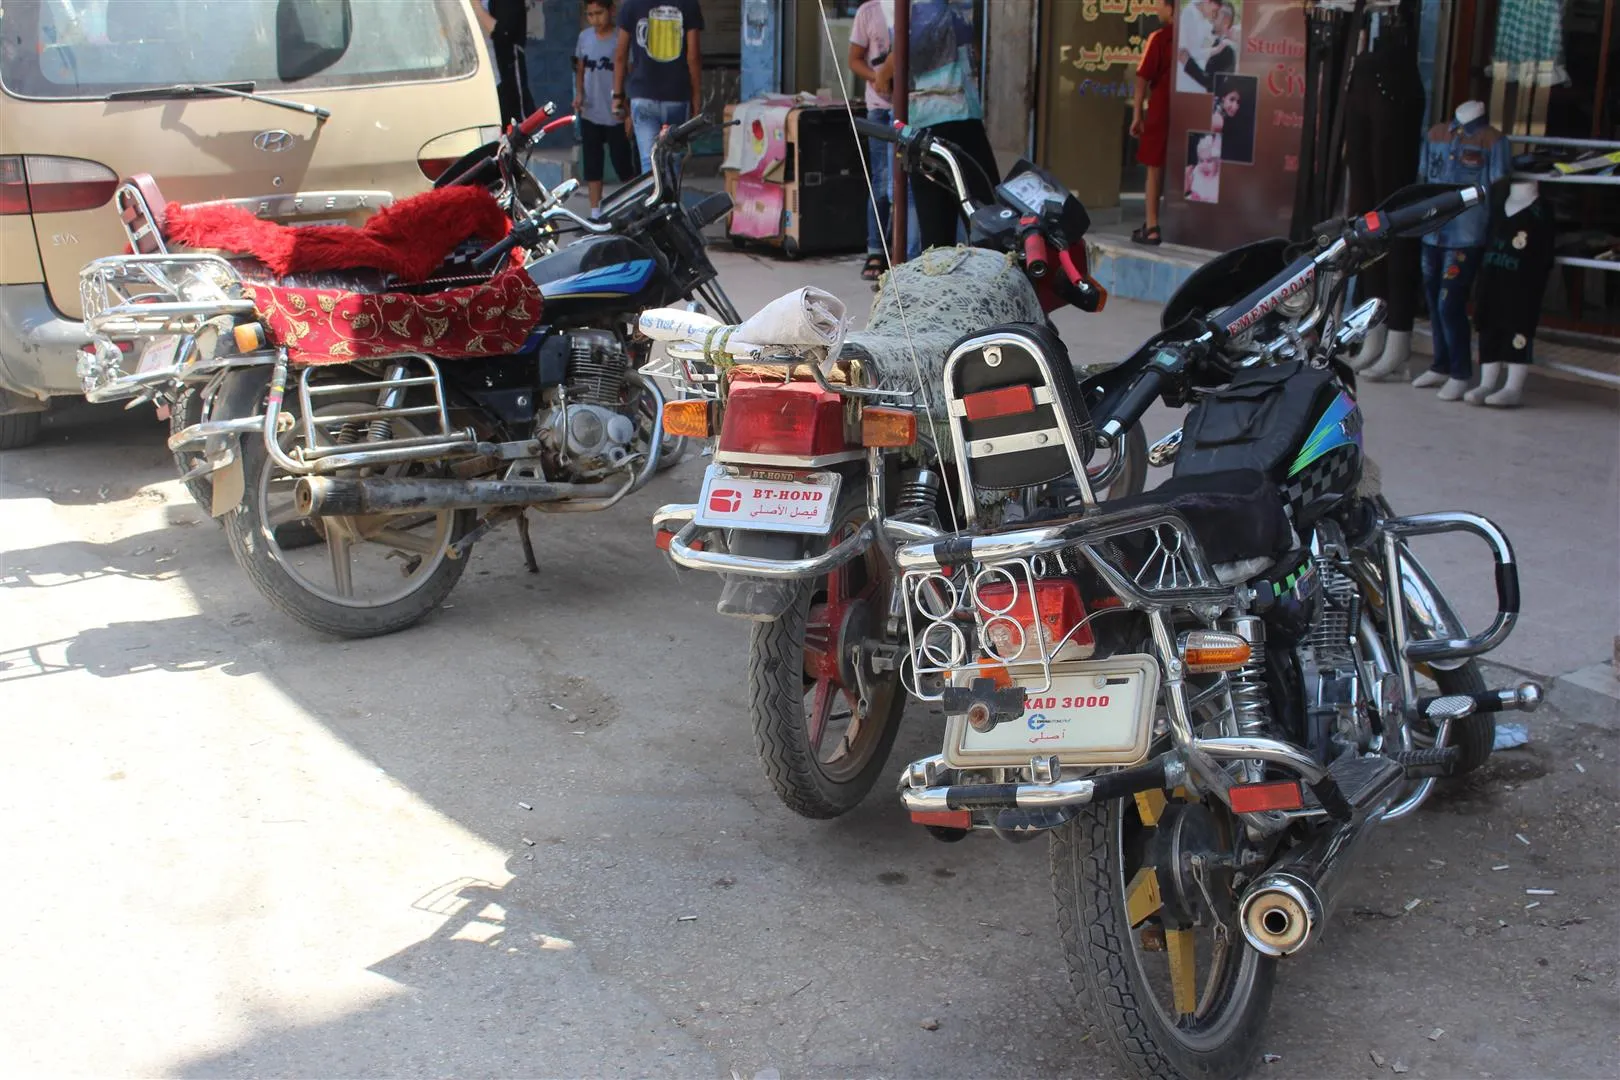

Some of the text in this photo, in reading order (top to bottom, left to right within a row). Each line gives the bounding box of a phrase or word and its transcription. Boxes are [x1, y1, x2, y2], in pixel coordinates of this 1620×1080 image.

[1281, 268, 1315, 298] 2017
[752, 470, 794, 481] BT-HOND
[752, 488, 823, 501] BT-HOND
[1062, 695, 1110, 708] 3000
